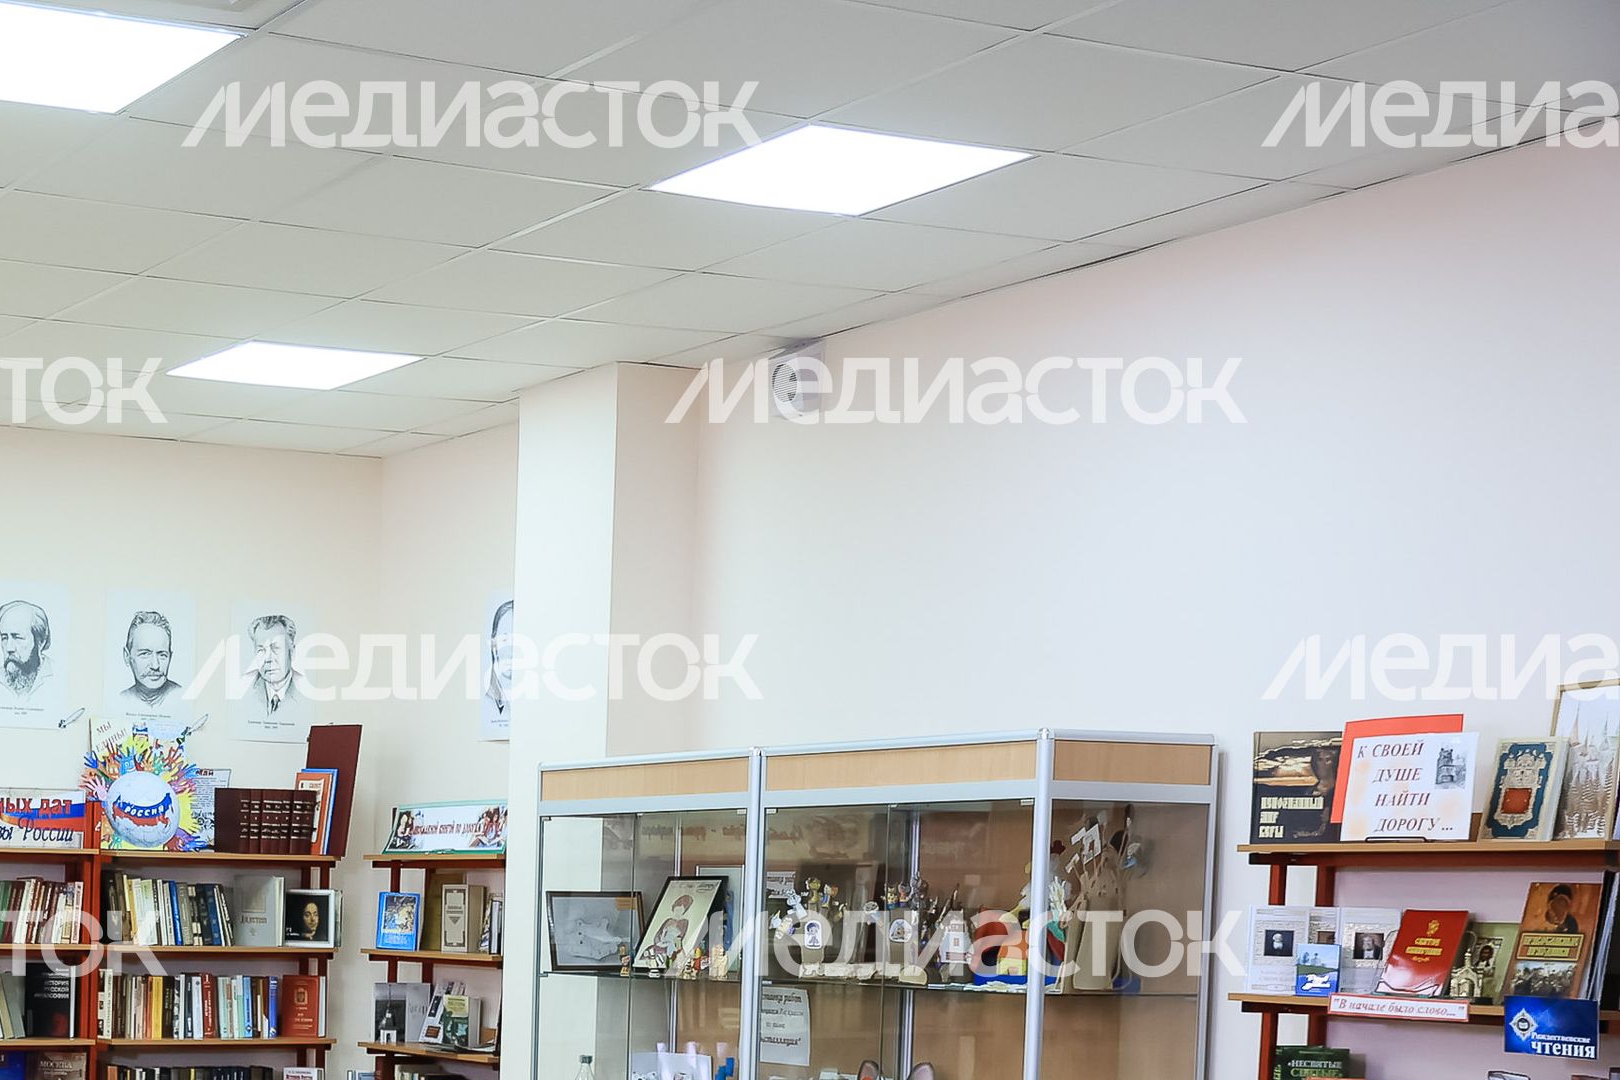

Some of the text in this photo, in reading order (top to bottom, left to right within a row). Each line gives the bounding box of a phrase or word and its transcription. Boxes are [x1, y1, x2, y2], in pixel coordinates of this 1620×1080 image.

[96, 721, 111, 734] МЫ
[1357, 739, 1425, 758] К СВОЕЙ
[1372, 767, 1423, 783] ДУШЕ
[39, 798, 72, 816] дат
[1375, 790, 1431, 807] НАЙТИ
[19, 814, 74, 842] России
[1373, 817, 1441, 833] ДОРОГУ
[1349, 1002, 1385, 1011] начале
[1388, 1002, 1414, 1013] было
[1531, 1041, 1595, 1059] чтения
